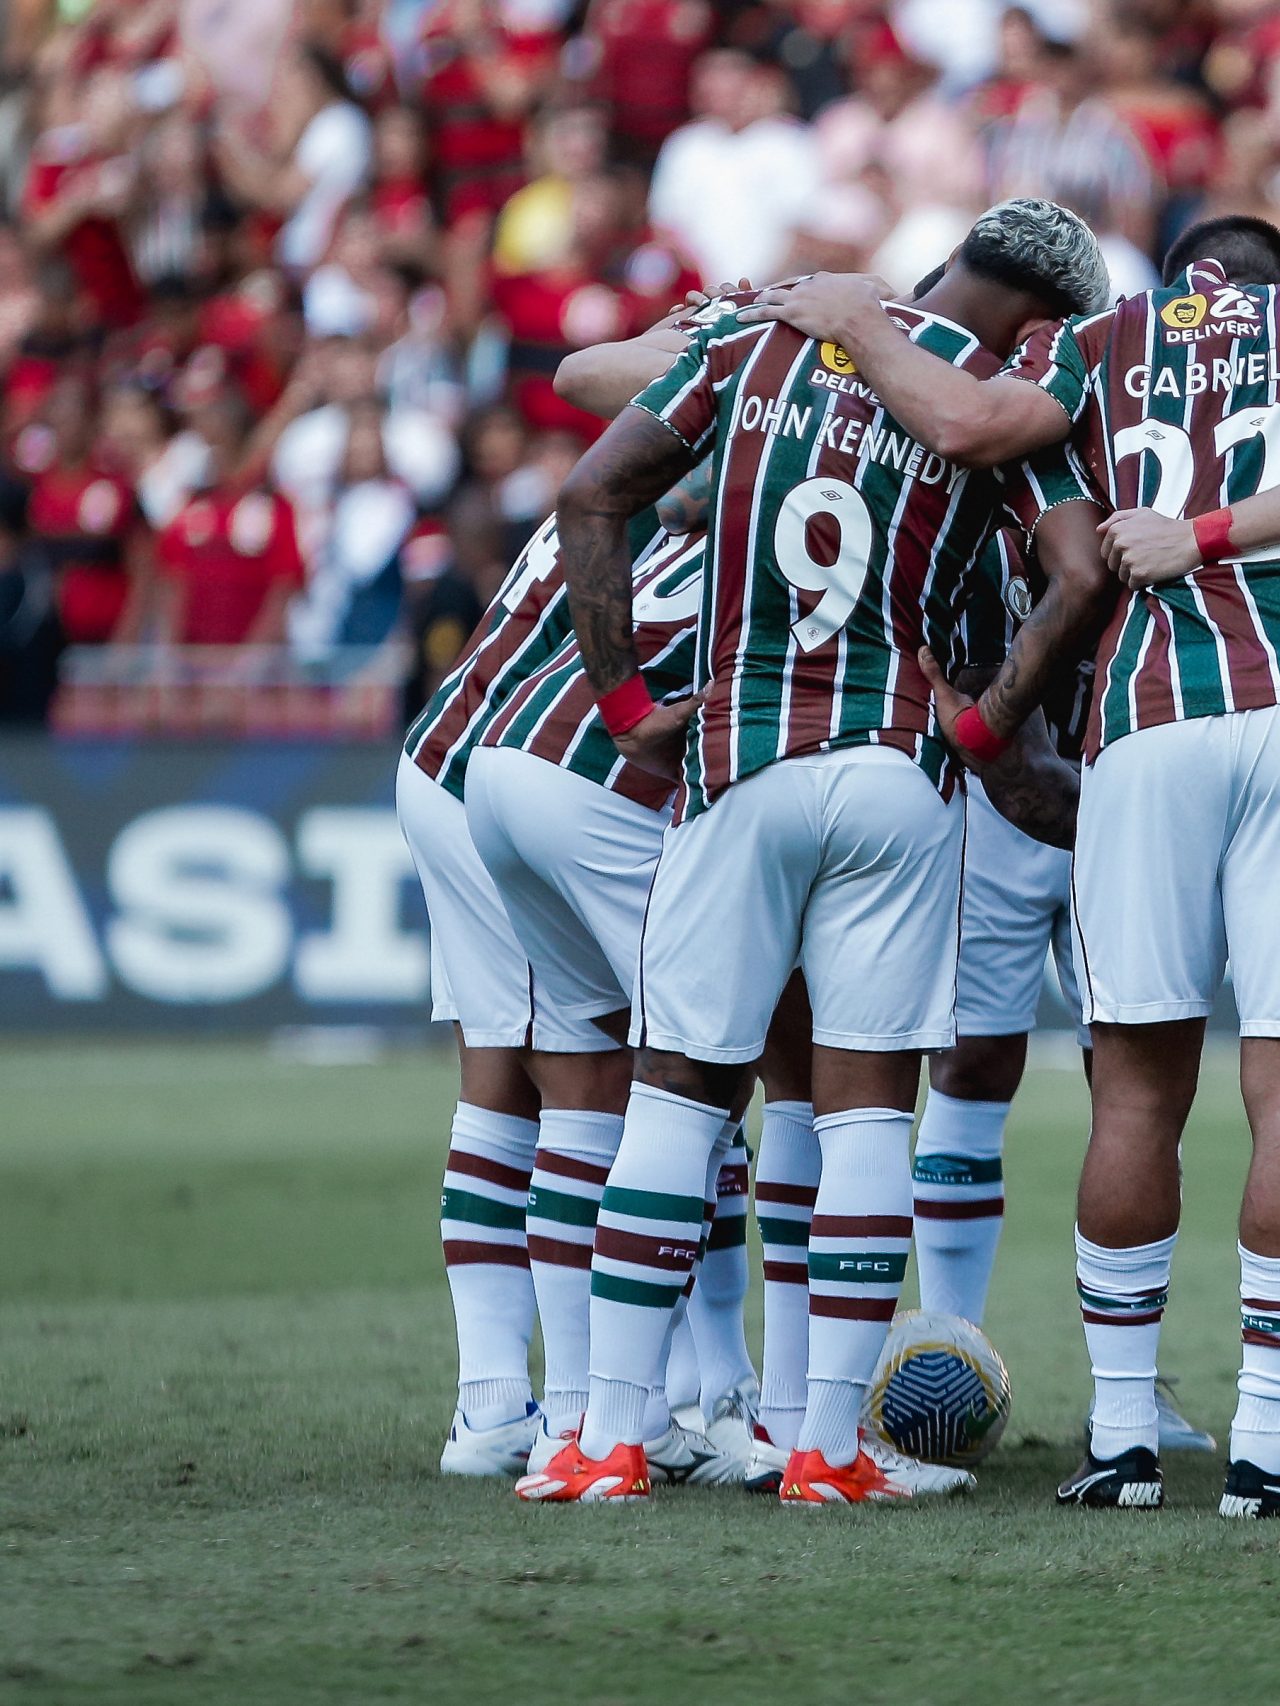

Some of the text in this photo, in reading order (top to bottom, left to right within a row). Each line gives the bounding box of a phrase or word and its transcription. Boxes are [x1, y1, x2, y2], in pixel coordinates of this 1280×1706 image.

[1166, 320, 1261, 342] DELIVERY
[729, 395, 970, 495] JOHN KENNEDY
[774, 477, 872, 653] 9
[839, 1260, 890, 1272] FFC
[1118, 1482, 1163, 1507] NIKE
